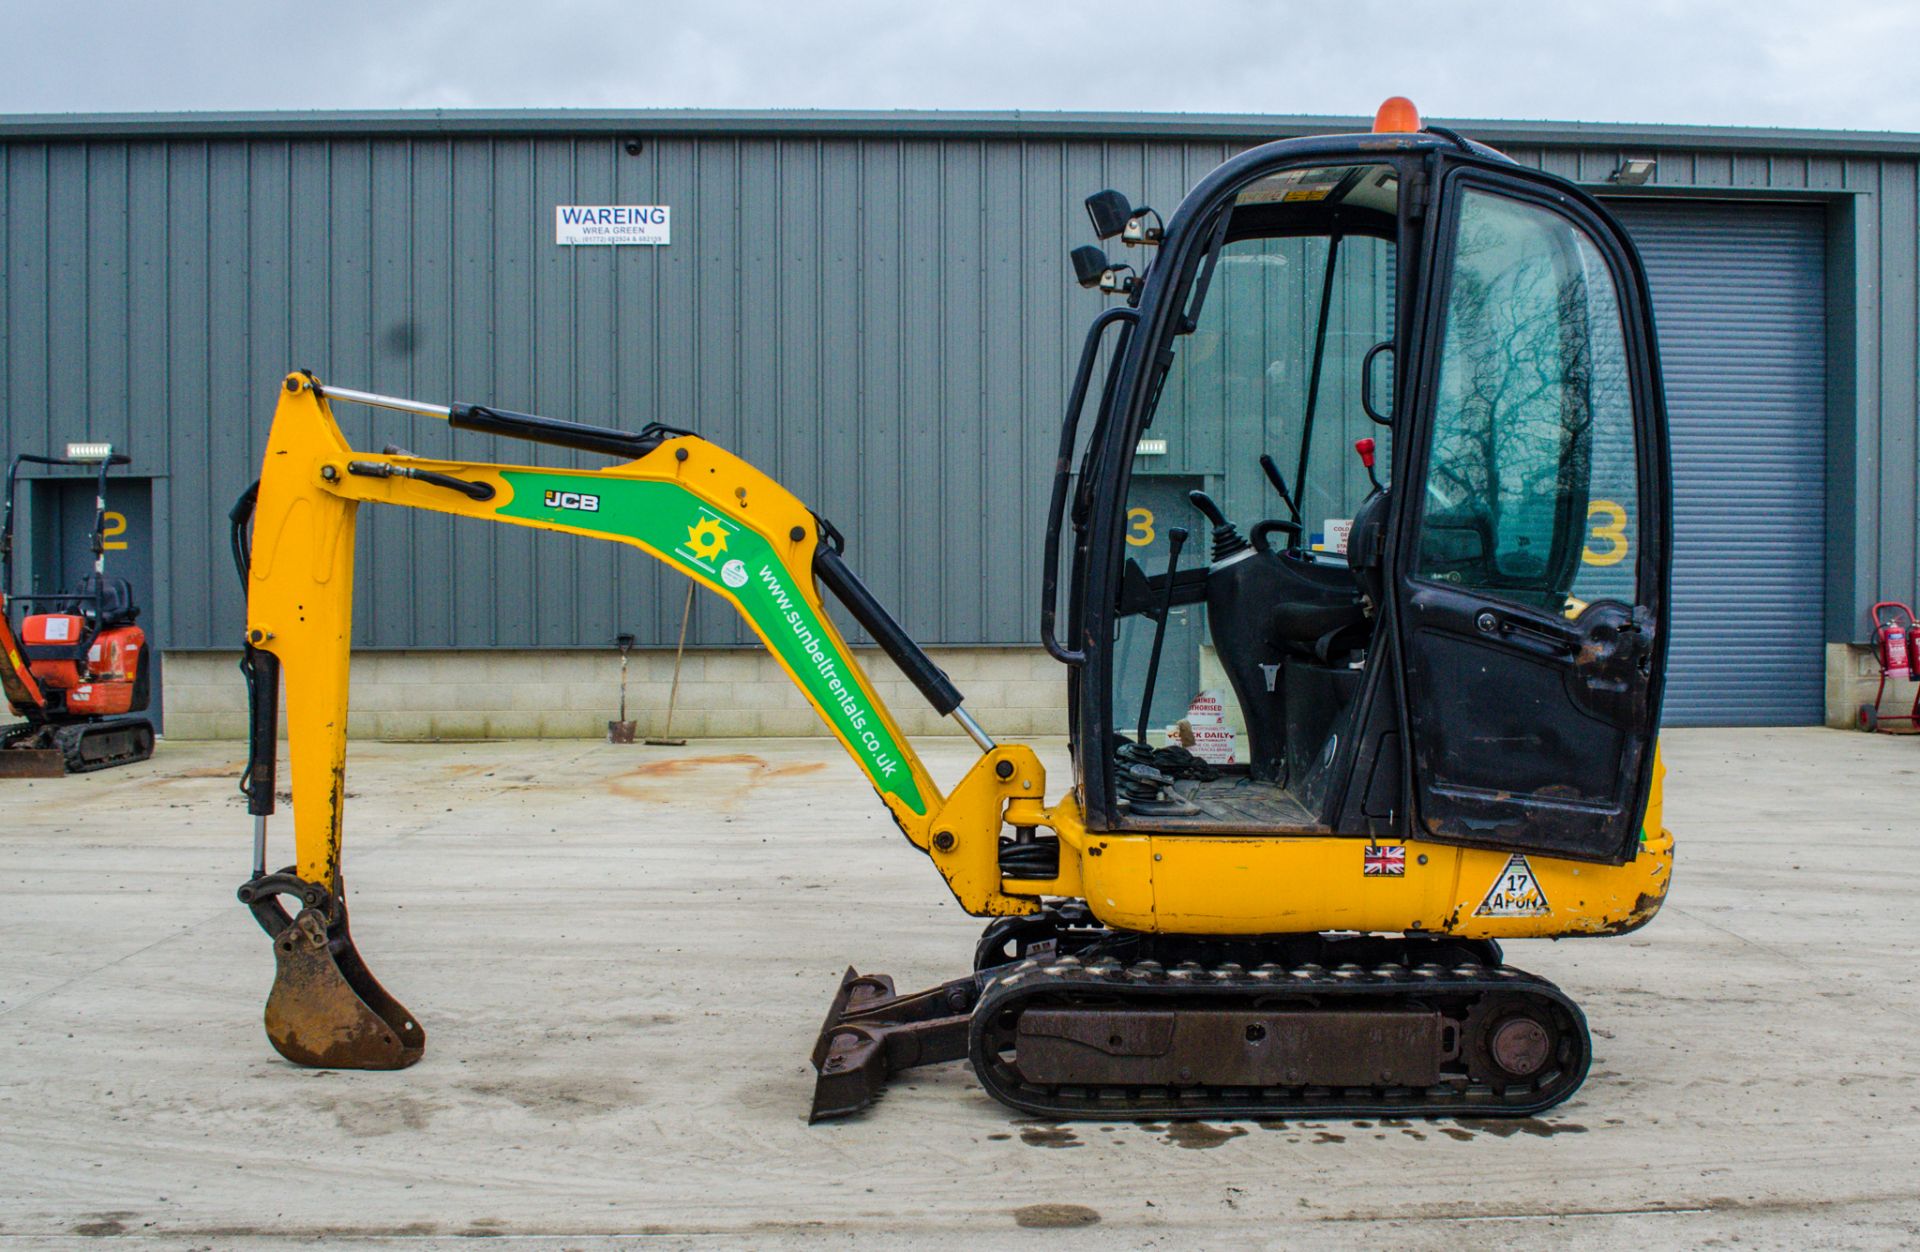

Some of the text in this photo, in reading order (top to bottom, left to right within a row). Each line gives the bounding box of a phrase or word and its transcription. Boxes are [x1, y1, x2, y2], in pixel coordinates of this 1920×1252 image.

[562, 208, 665, 225] WAREING
[583, 226, 645, 234] WREA GREEN
[545, 491, 599, 511] JCB
[103, 511, 128, 550] 2
[1125, 507, 1155, 546] 3
[1582, 499, 1629, 567] 3
[759, 565, 896, 778] www.sunbeltrentals.co.uk
[1507, 874, 1528, 891] 17
